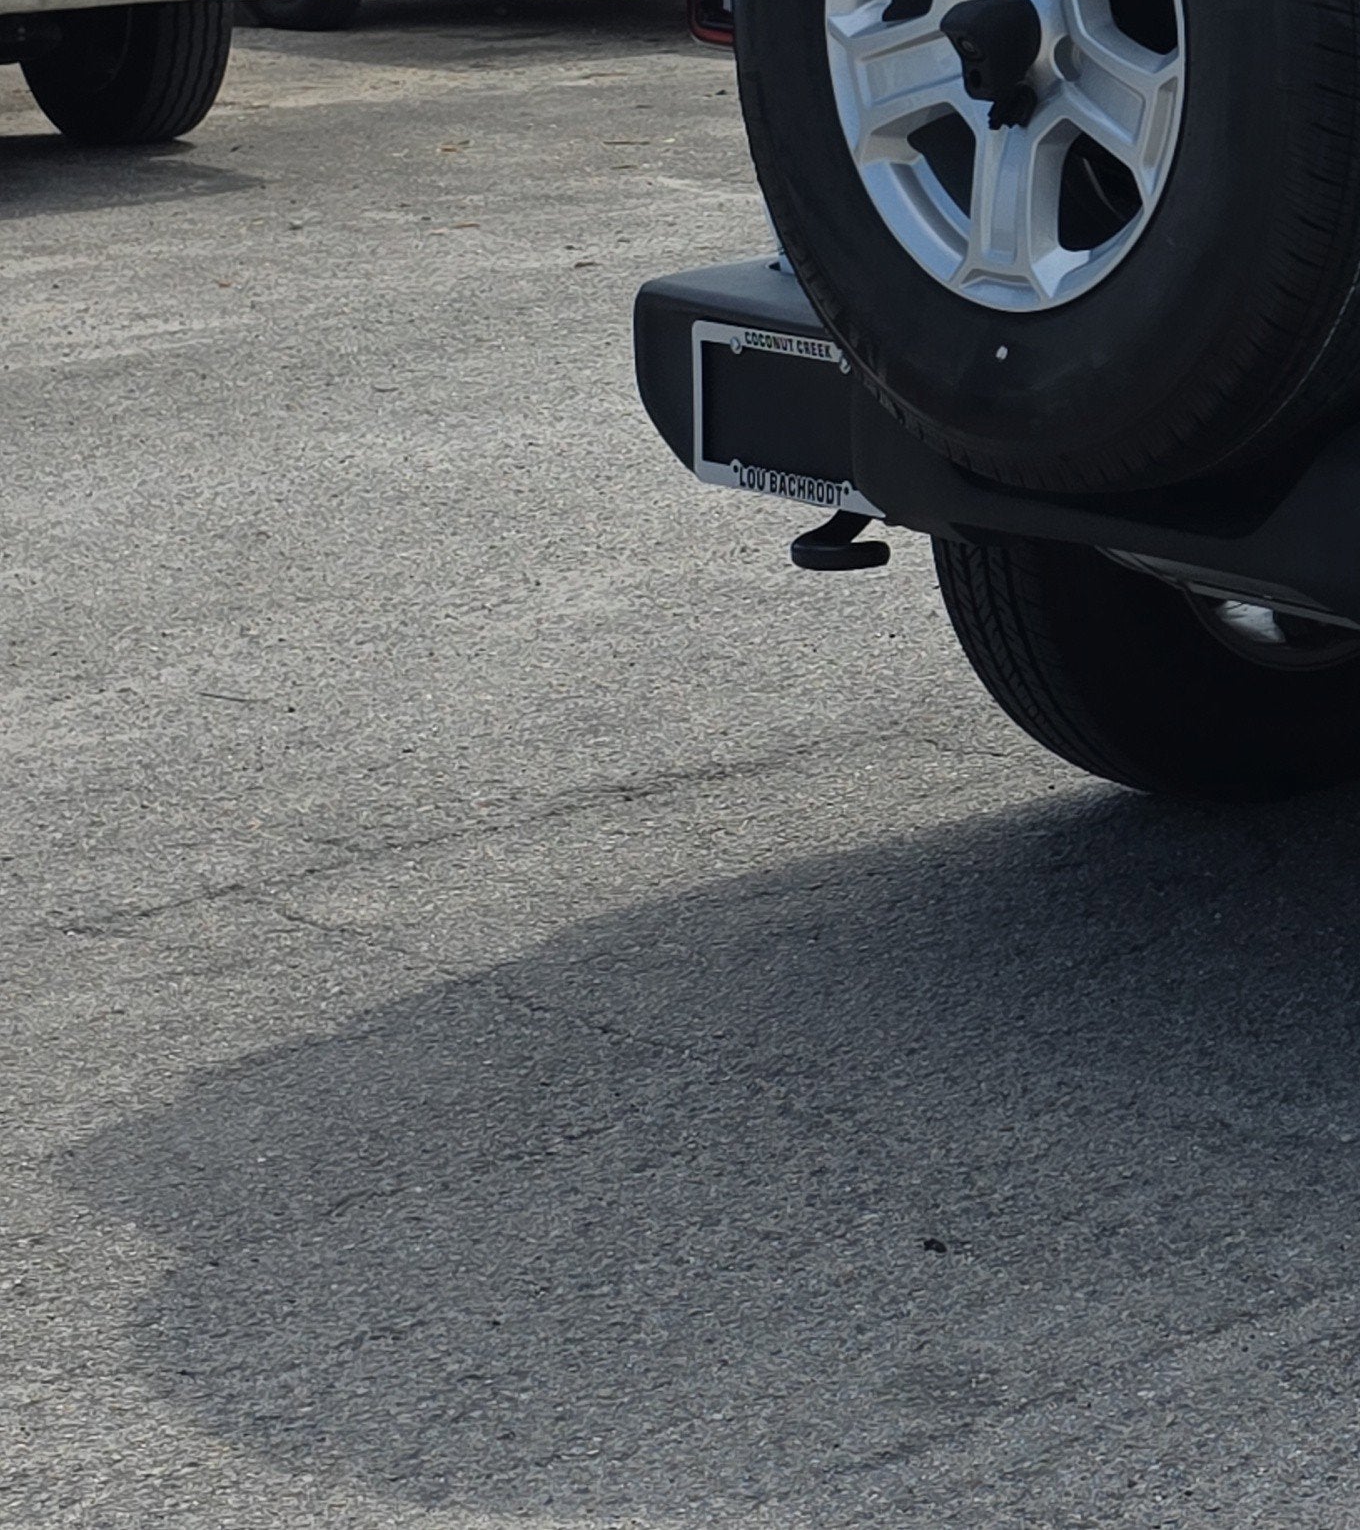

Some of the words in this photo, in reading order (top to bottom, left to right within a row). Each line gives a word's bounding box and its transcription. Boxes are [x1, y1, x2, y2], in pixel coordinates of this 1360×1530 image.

[744, 331, 795, 352] COCONUT
[796, 340, 833, 359] CREEK
[739, 466, 766, 492] LOU
[769, 470, 843, 507] BACHRODT
